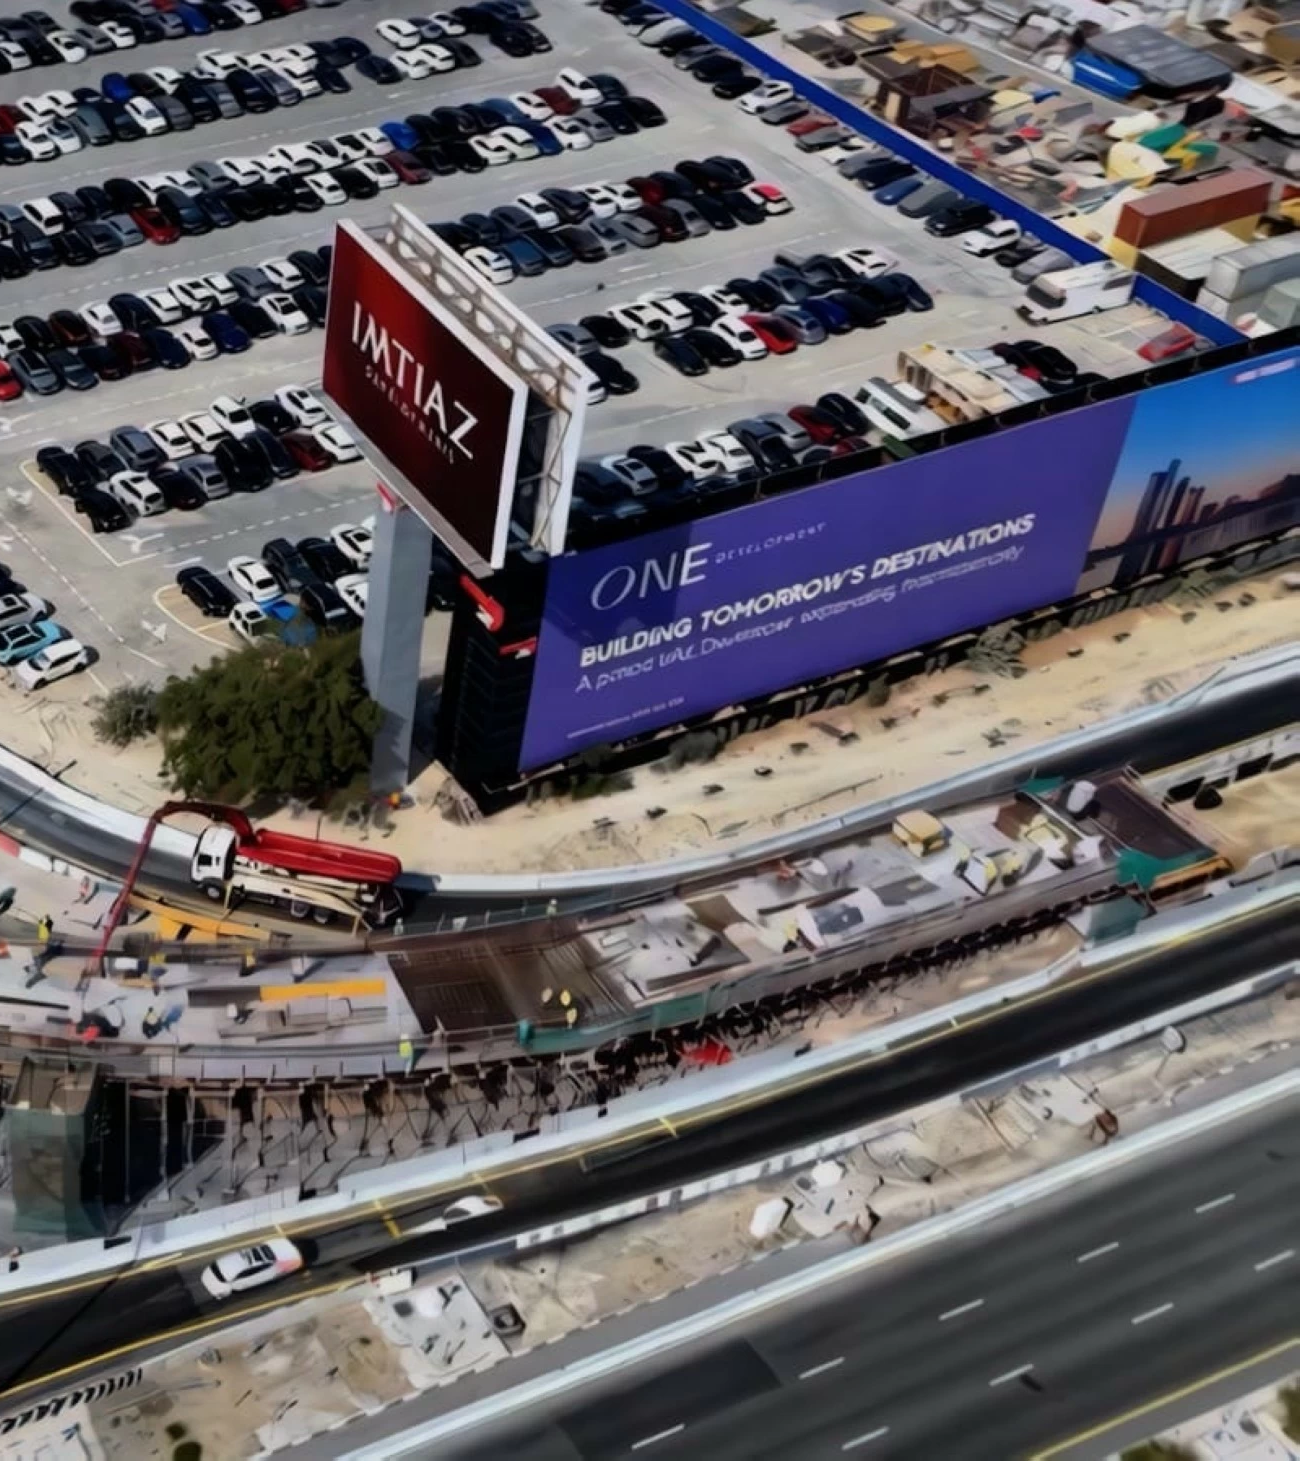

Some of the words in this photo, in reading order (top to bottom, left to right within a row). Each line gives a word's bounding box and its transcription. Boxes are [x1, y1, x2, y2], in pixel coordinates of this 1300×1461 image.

[352, 300, 478, 460] IMTIAZ
[580, 617, 693, 668] BUILDING
[701, 564, 868, 631] TOMORROW'S
[870, 513, 1036, 580] DESTINATIONS
[590, 542, 713, 611] ONE
